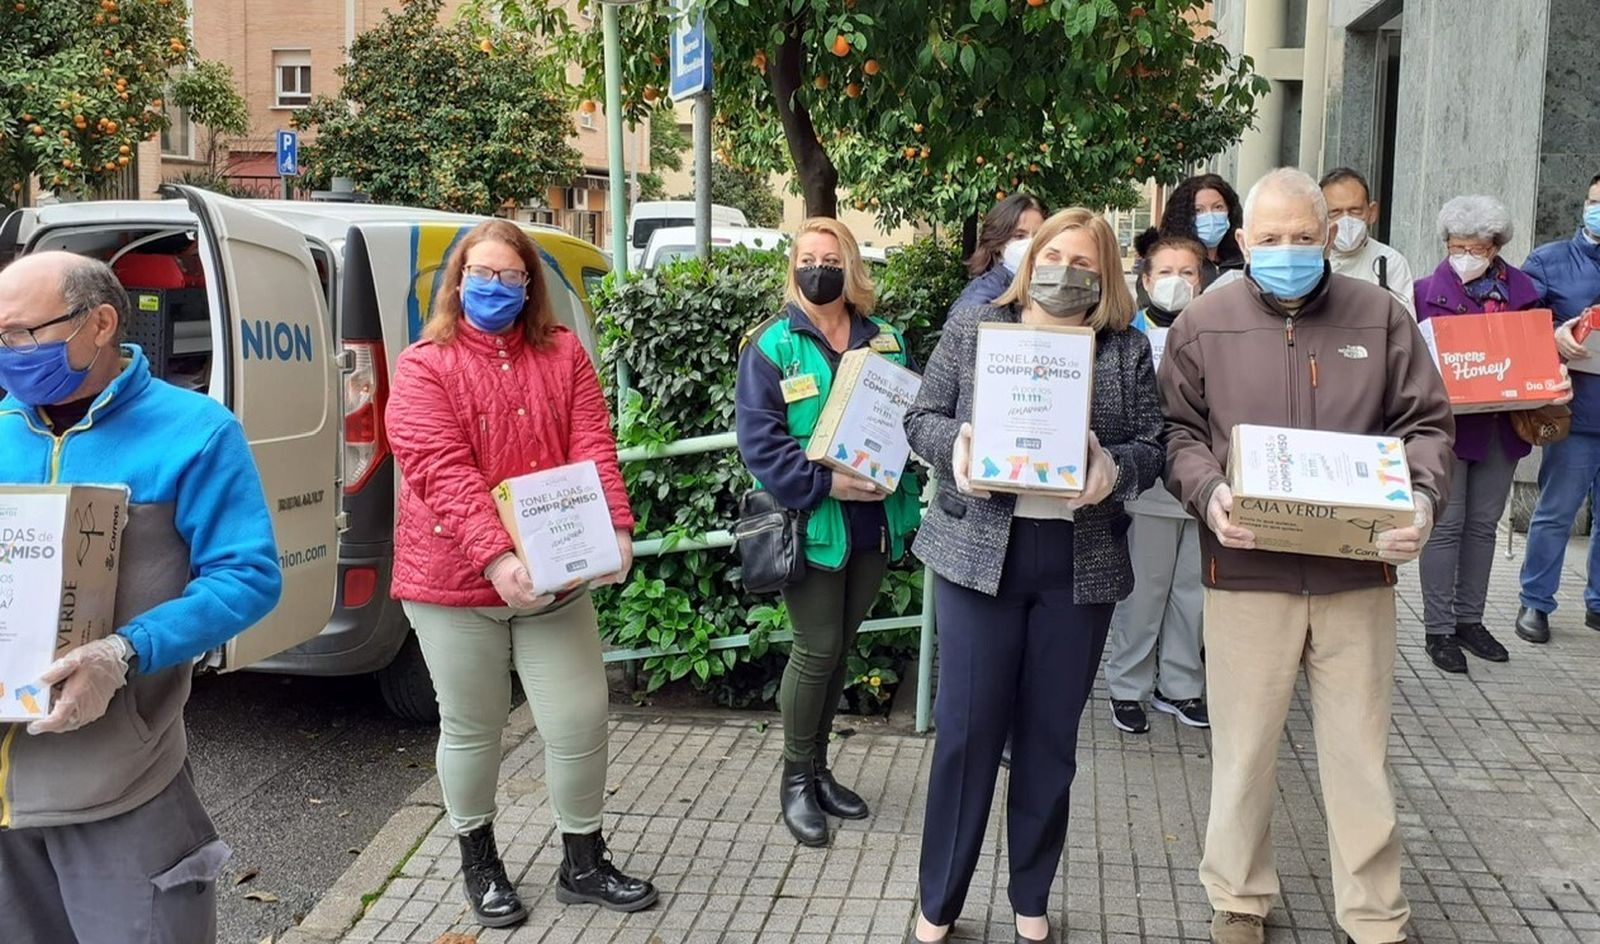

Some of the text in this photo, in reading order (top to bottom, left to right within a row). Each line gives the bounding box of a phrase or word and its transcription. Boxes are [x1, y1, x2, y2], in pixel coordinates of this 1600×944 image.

[283, 134, 293, 151] P
[240, 318, 312, 362] NION
[987, 364, 1081, 380] COMPROMISO
[989, 353, 1066, 367] TONELADAS
[1452, 358, 1512, 381] Honey
[863, 378, 911, 409] COMPROMI
[866, 370, 915, 402] TONELADAS
[1265, 442, 1280, 491] TONELADAS
[1277, 434, 1292, 493] COMPROMISO
[277, 490, 325, 512] RENAULT
[519, 486, 583, 507] TONELADAS
[521, 492, 598, 518] COMPROMISO
[1240, 498, 1338, 519] CAJA VERDE
[110, 504, 119, 551] Correos
[57, 580, 77, 650] VERDE
